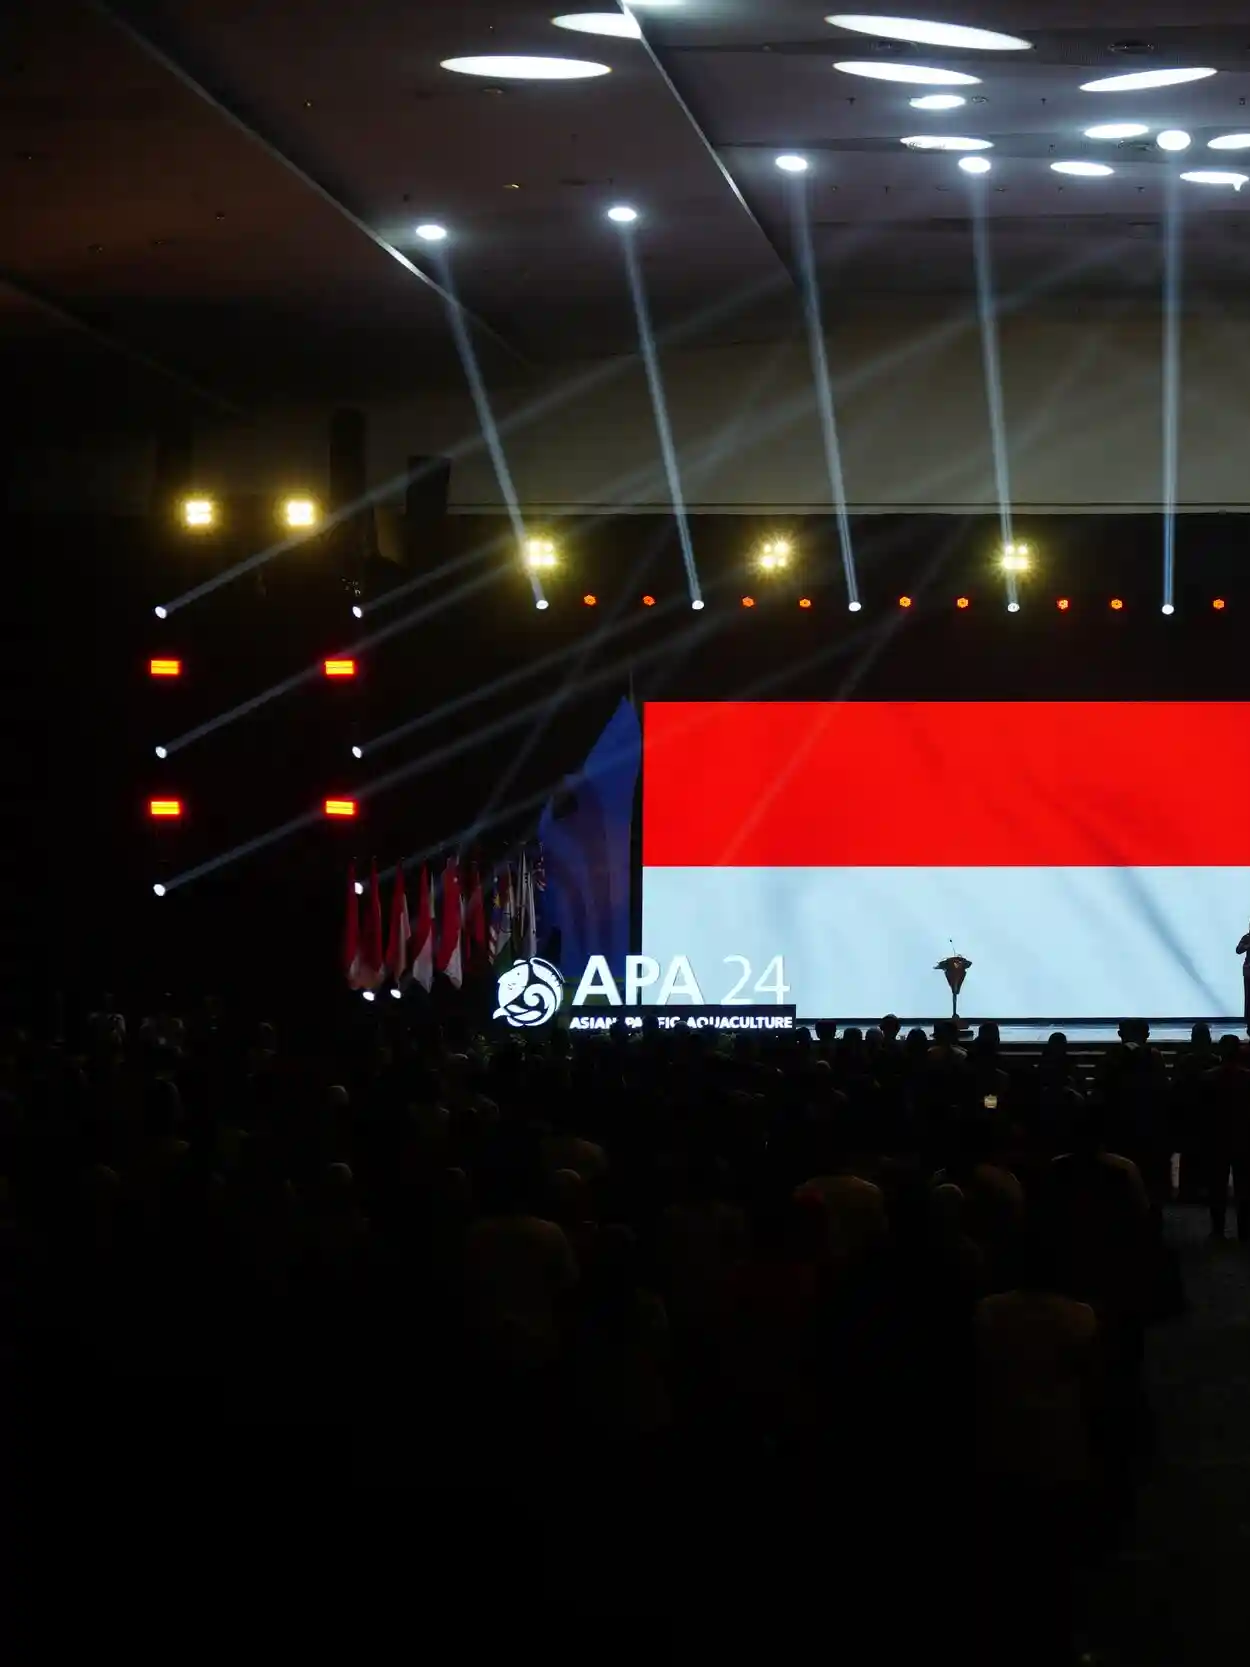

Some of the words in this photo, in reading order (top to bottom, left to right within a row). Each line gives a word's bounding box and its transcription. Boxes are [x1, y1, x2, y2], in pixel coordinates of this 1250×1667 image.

[571, 955, 706, 1005] APA
[720, 954, 791, 1005] 24
[624, 1016, 681, 1029] PAFIC
[686, 1016, 793, 1029] AQUACULTURE
